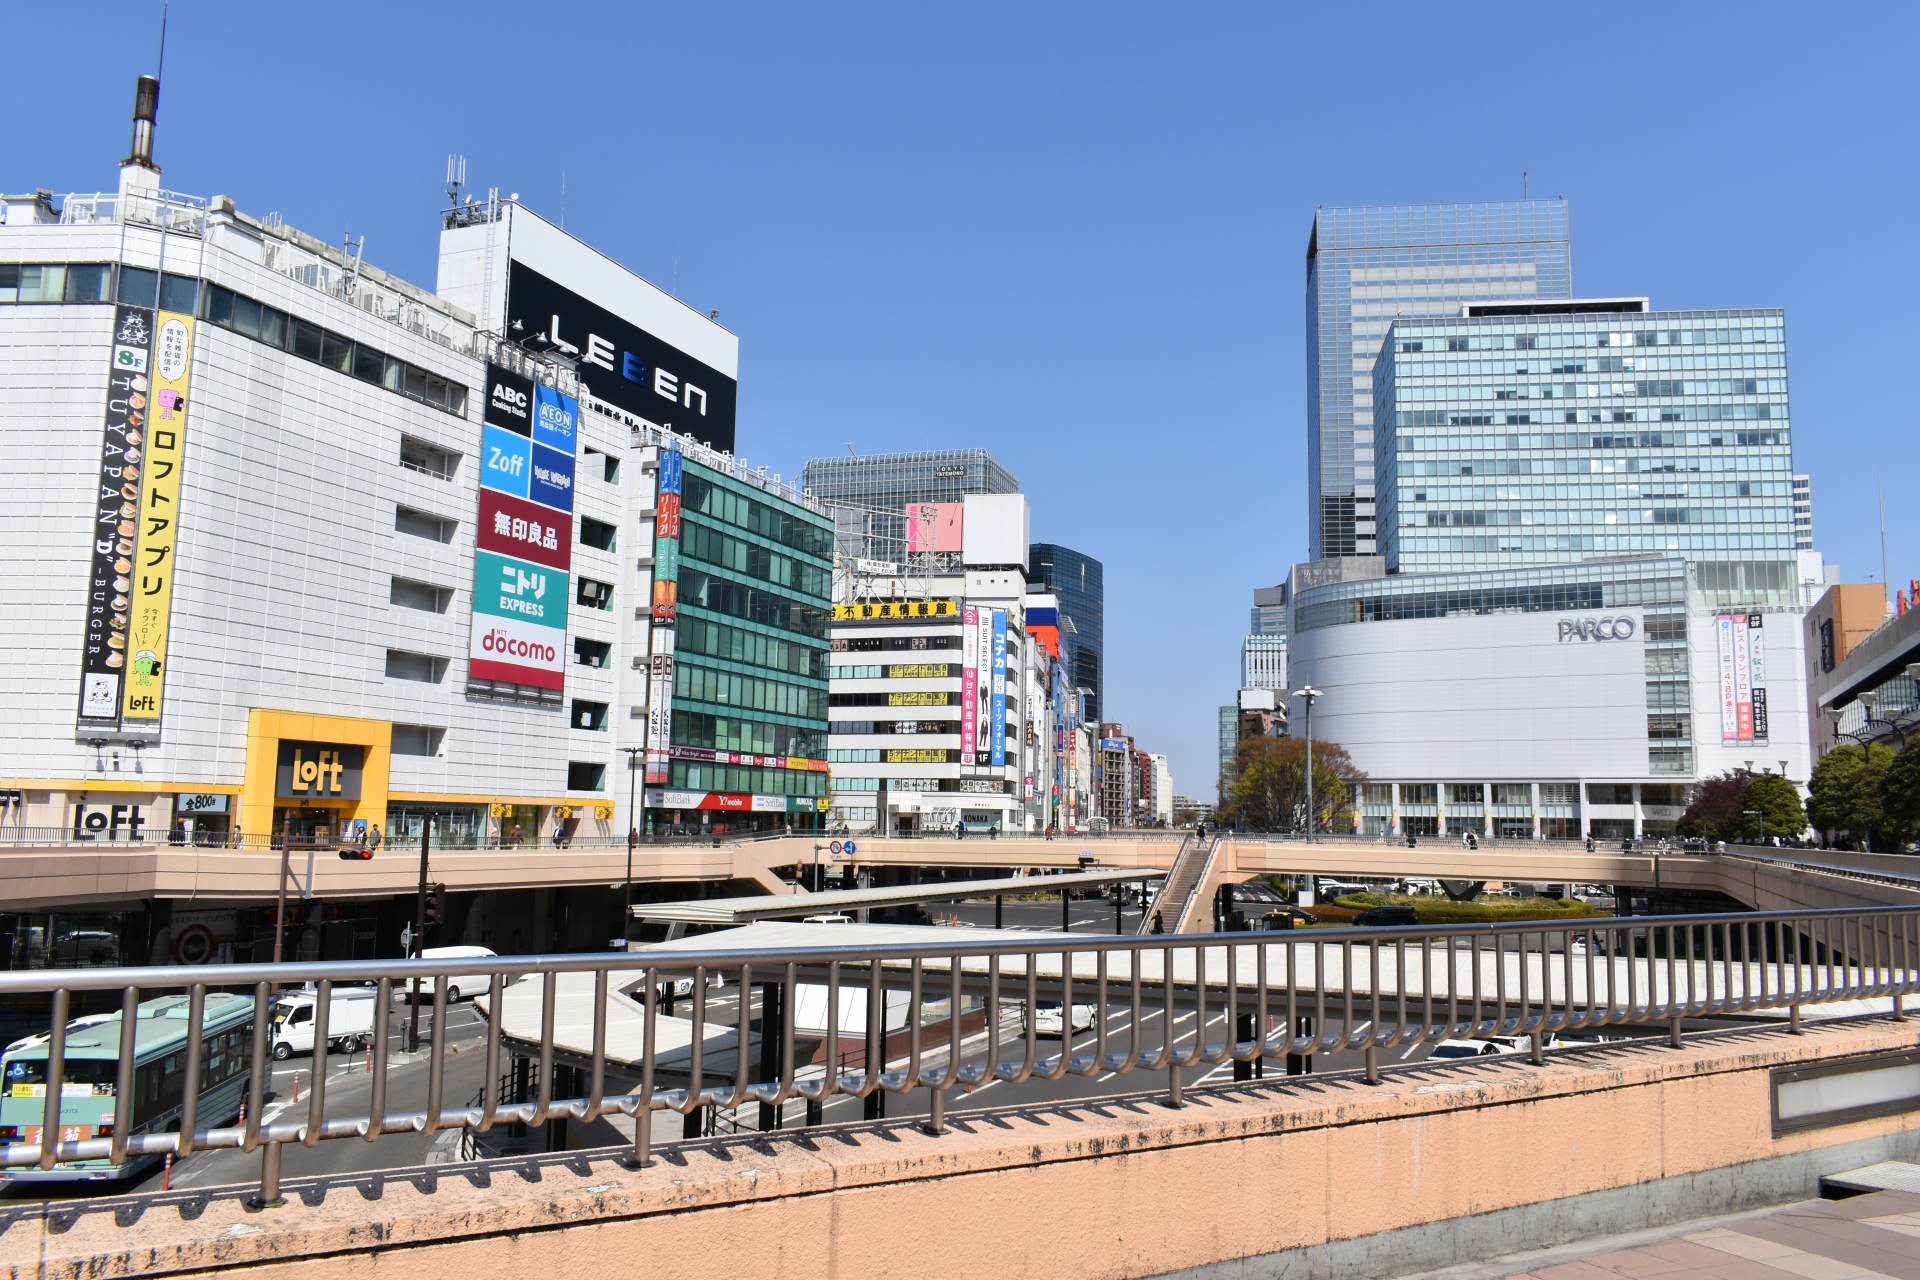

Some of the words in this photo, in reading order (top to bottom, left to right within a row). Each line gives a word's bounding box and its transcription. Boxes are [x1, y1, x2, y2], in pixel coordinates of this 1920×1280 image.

[118, 350, 144, 368] 8F
[163, 328, 174, 372] 情報を配信中
[174, 330, 184, 366] 旬な雑貨の
[492, 384, 527, 407] ABC
[492, 398, 511, 414] Cooking
[512, 406, 526, 418] Studio
[540, 404, 572, 428] AEON
[100, 378, 130, 525] TUYAPAN
[488, 447, 523, 477] Zoff
[142, 430, 176, 596] ロフトアプリ
[659, 494, 670, 535] リーブ21
[494, 511, 558, 550] 無印良品
[500, 566, 546, 600] ニトリ
[500, 596, 544, 617] EXPRESS
[142, 608, 150, 645] ダウンロード
[1560, 615, 1636, 639] PARCO
[482, 628, 556, 662] docomo
[995, 634, 1004, 669] コナカ
[1737, 626, 1747, 700] レストランフロア
[965, 670, 973, 752] 仙台不動産情報館
[1740, 706, 1749, 730] 営業中
[978, 754, 988, 763] 1F
[665, 794, 692, 805] SoftBank
[766, 798, 785, 807] SoftBank
[964, 815, 988, 823] KONAKA
[680, 982, 690, 991] GO
